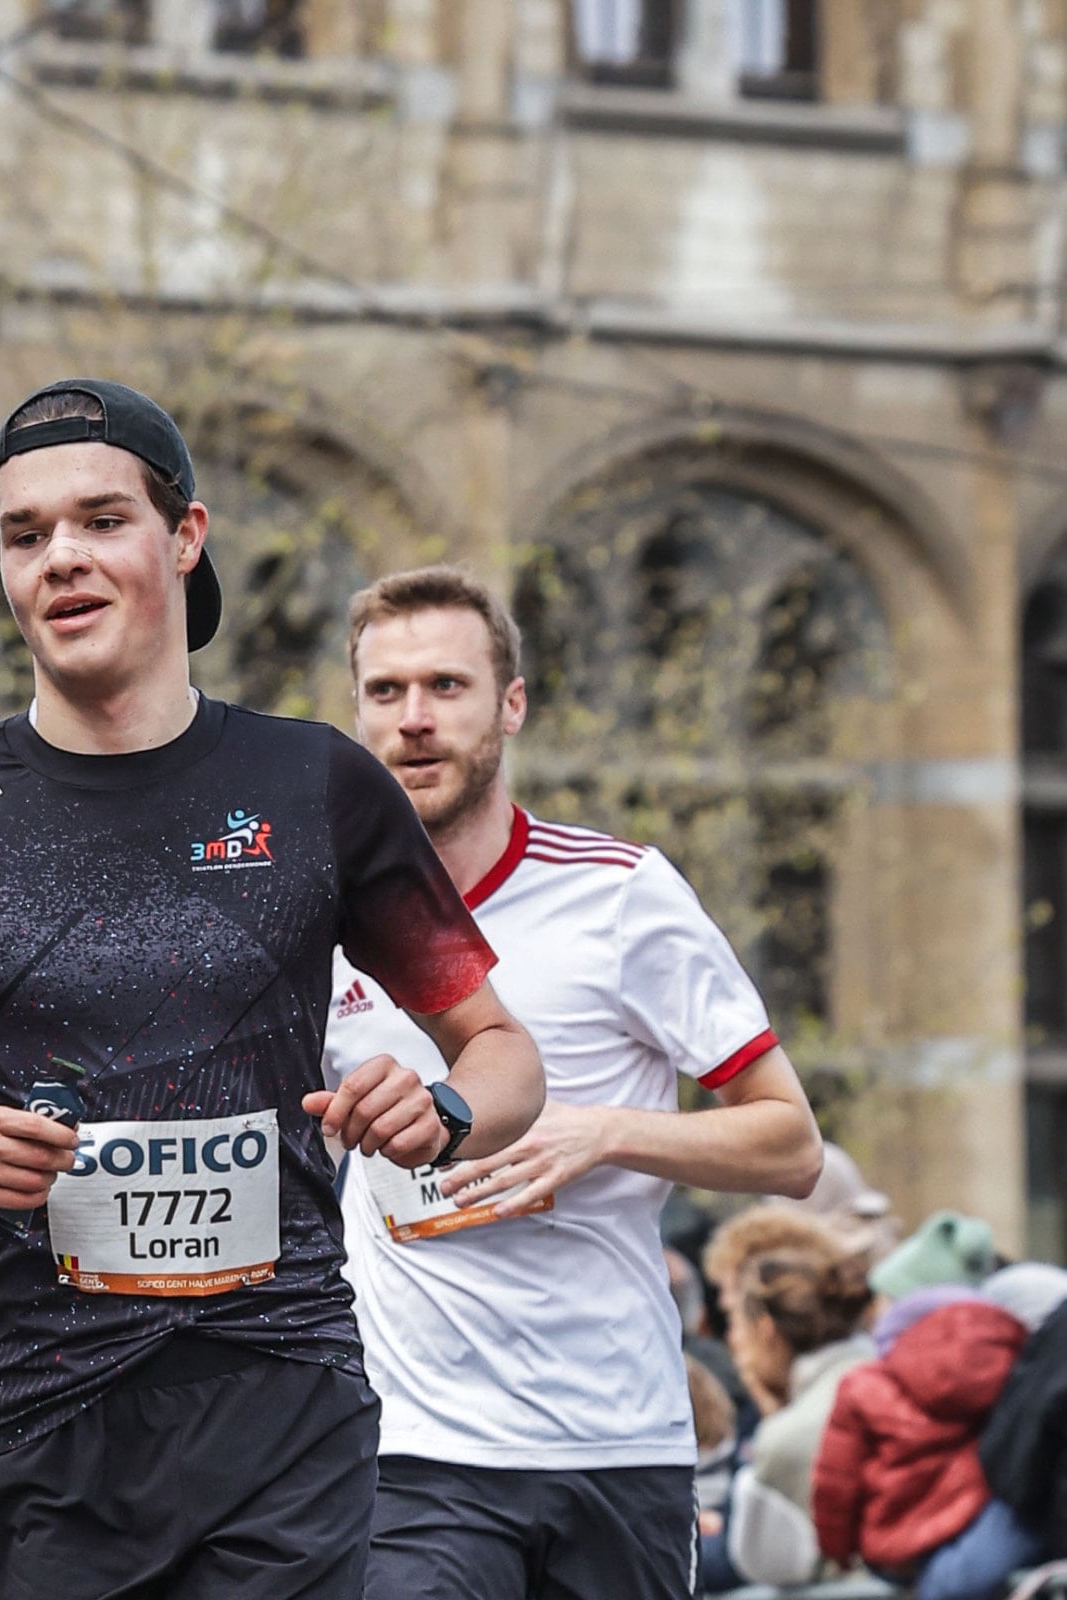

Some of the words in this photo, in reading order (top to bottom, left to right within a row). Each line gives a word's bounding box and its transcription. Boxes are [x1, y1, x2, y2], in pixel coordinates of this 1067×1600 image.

[337, 1000, 374, 1019] adidas
[66, 1130, 268, 1177] SOFICO
[113, 1188, 232, 1226] 17772
[129, 1232, 220, 1259] Loran
